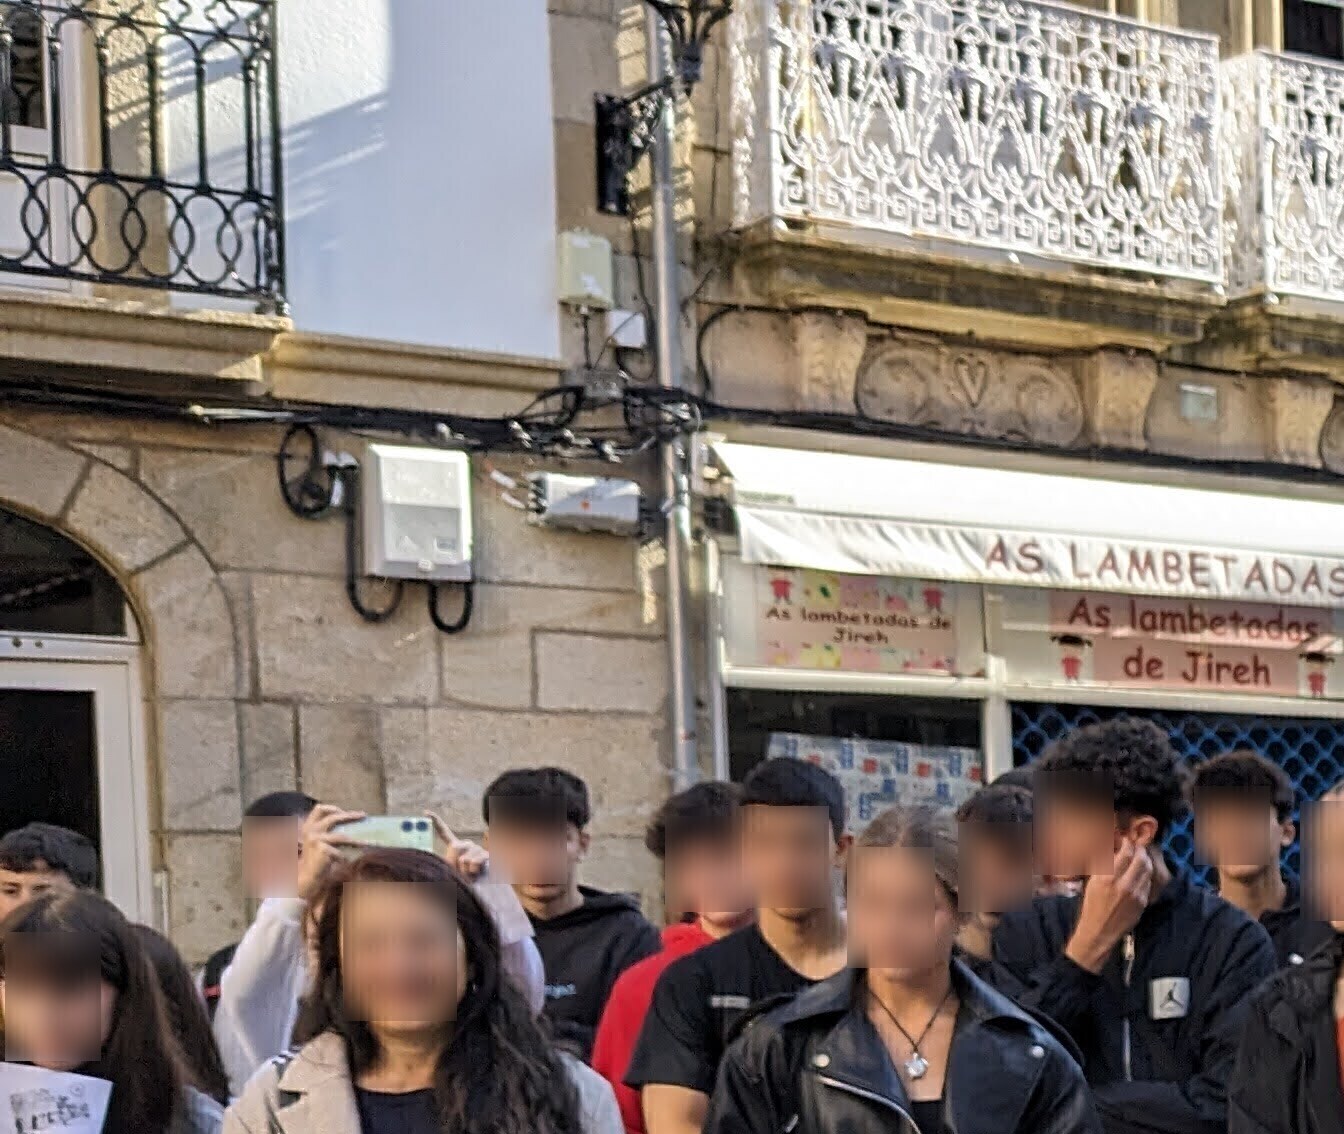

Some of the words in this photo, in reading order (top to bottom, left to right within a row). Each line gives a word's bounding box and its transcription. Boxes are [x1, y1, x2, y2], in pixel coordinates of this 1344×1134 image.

[985, 535, 1044, 574] AS
[765, 606, 792, 621] As
[800, 606, 919, 629] lambetadas
[832, 626, 889, 644] Jireh
[1068, 596, 1111, 629] As
[1129, 599, 1320, 643] lambetadas
[1123, 646, 1165, 680] de
[1181, 651, 1271, 686] Jireh
